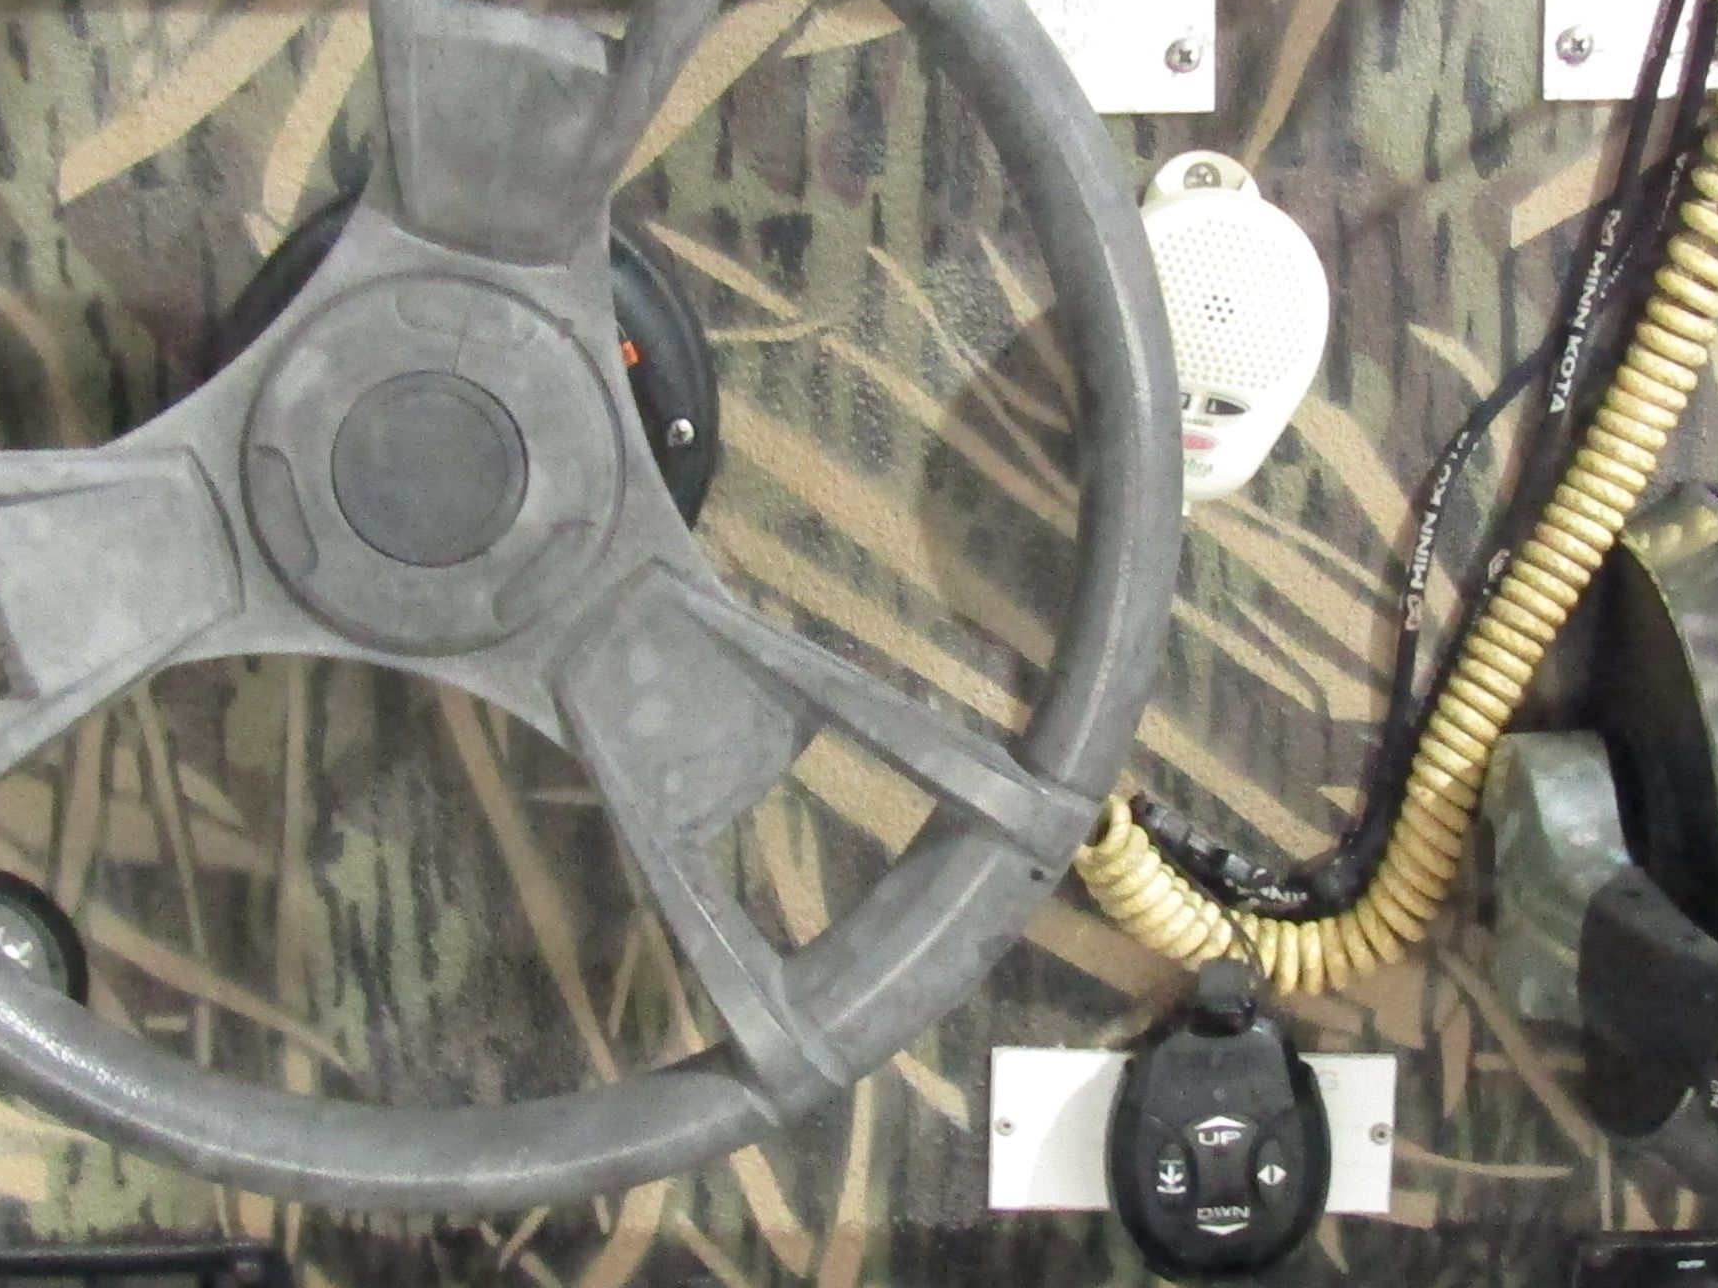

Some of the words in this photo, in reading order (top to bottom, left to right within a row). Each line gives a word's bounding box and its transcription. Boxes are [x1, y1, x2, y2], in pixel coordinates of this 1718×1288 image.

[1574, 249, 1607, 330] MINN
[1549, 334, 1583, 413] KOTA
[1409, 511, 1438, 591] MINN
[1198, 1130, 1242, 1146] UP
[1196, 1205, 1251, 1221] DWN
